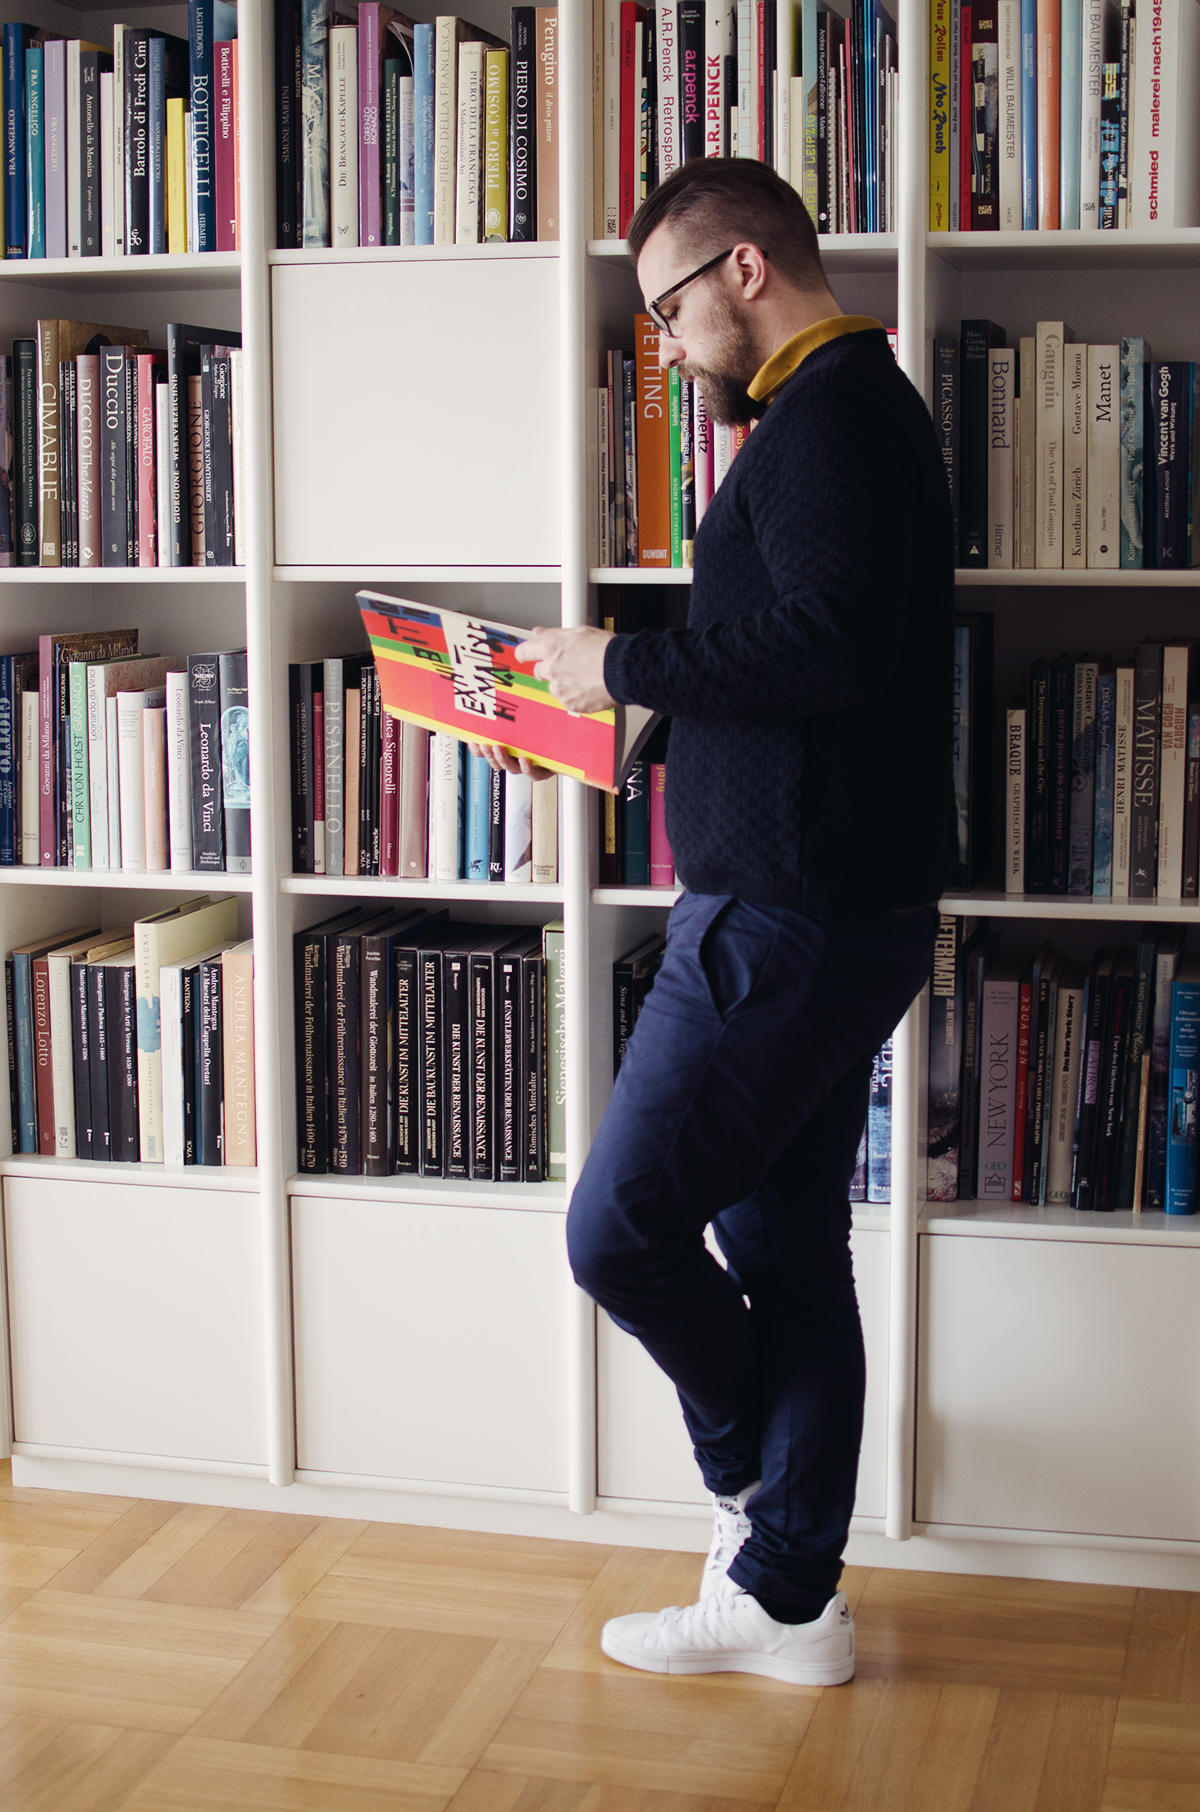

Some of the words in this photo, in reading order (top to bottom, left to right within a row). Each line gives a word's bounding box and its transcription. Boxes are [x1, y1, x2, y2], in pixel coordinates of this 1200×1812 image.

[196, 7, 204, 58] LIGHTBOWN
[661, 8, 674, 82] A.R.Penck
[818, 29, 827, 50] Andrea
[134, 41, 148, 68] Cini
[220, 47, 231, 87] Botticelli
[540, 18, 558, 85] Perugino
[1152, 36, 1163, 75] nach
[30, 70, 39, 86] FRA
[133, 74, 146, 105] Fredi
[468, 71, 478, 101] PIERO
[487, 65, 501, 124] COSIMO
[515, 61, 528, 107] PIERO
[682, 50, 700, 123] a.r.penck
[932, 73, 948, 107] Neo
[1005, 66, 1015, 91] WILLI
[30, 90, 39, 135] ANGELICO
[85, 95, 95, 132] Antonello
[134, 112, 146, 123] di
[219, 98, 232, 138] Filippino
[468, 106, 478, 140] DELLA
[515, 113, 528, 130] DI
[545, 100, 554, 116] divin
[1151, 79, 1161, 137] malerei
[86, 135, 95, 144] da
[192, 74, 210, 197] BOTTICELLI
[363, 107, 371, 145] LORENZO
[370, 107, 378, 145] MONACO
[545, 119, 554, 142] pittore
[662, 97, 677, 179] Retrospekt
[818, 116, 827, 138] Malerei
[932, 110, 948, 153] Rauch
[1005, 95, 1015, 159] BAUMEISTER
[85, 147, 95, 177] Messina
[133, 129, 146, 176] Bartolo
[487, 141, 500, 188] PIERO
[515, 136, 528, 200] COSIMO
[467, 144, 477, 204] FRANCESCA
[1148, 150, 1160, 220] schmied
[198, 213, 207, 246] HIRMER
[43, 331, 52, 365] BELLOSI
[215, 363, 228, 398] Giorgione
[1041, 334, 1061, 409] Gauguin
[1072, 353, 1082, 389] Moreau
[1158, 366, 1170, 396] Gogh
[104, 354, 124, 429] Duccio
[991, 361, 1010, 449] Bonnard
[1095, 364, 1112, 422] Manet
[79, 378, 92, 448] DUCCIO
[1072, 394, 1082, 435] Gustave
[1159, 400, 1169, 419] van
[1169, 403, 1177, 429] Wirkung
[38, 383, 58, 500] CIMABUE
[141, 408, 153, 466] GAROFALO
[203, 410, 212, 448] GIORGIONE
[1157, 422, 1169, 464] Vincent
[80, 451, 93, 477] The
[1048, 440, 1057, 457] The
[188, 401, 205, 534] GIORGIONE
[1048, 459, 1057, 473] Art
[1048, 475, 1057, 486] of
[1071, 467, 1082, 499] Zürich
[80, 478, 94, 521] Maestà
[1047, 488, 1057, 506] Paul
[994, 524, 1004, 557] Hirmer
[1046, 508, 1057, 546] Gauguin
[1071, 503, 1082, 556] Kunsthaus
[641, 549, 668, 558] DUMONT
[175, 688, 185, 726] Leonardo
[1101, 687, 1111, 721] DEGAS
[1163, 703, 1175, 728] GOGH
[175, 727, 185, 738] da
[384, 712, 396, 738] Luca
[1099, 725, 1109, 746] beyond
[1162, 731, 1174, 749] VAN
[1173, 707, 1186, 748] GAUGUIN
[73, 735, 84, 768] HOLST
[176, 740, 185, 759] Vinci
[199, 723, 213, 779] Leonardo
[1008, 725, 1022, 775] BRAQUE
[1117, 725, 1127, 773] MATISSE
[1134, 698, 1156, 807] MATISSE
[325, 701, 341, 833] PISANELLO
[383, 742, 396, 794] Signorelli
[75, 772, 84, 797] VON
[201, 783, 212, 797] da
[1115, 778, 1125, 814] HENRI
[75, 800, 85, 823] CHR
[202, 801, 215, 832] Vinci
[1012, 783, 1021, 845] GRAPHISCHES
[1012, 849, 1021, 874] WERK
[303, 945, 314, 998] Wandmalerei
[312, 945, 321, 968] Roettgen
[335, 945, 346, 1000] Wandmalerei
[344, 945, 352, 968] Roettgen
[933, 916, 957, 996] AFTERMATH
[203, 978, 211, 1004] Maestri
[210, 968, 219, 994] Andrea
[369, 970, 379, 1019] Wandmalerei
[619, 986, 628, 1007] Siena
[35, 971, 49, 1026] Lorenzo
[202, 1006, 211, 1023] della
[210, 996, 219, 1030] Mantegna
[235, 975, 247, 1043] ANDREA
[304, 1001, 314, 1014] der
[336, 1002, 346, 1015] der
[619, 1009, 628, 1022] and
[946, 998, 955, 1010] JOEL
[201, 1026, 211, 1057] Cappella
[369, 1022, 379, 1034] der
[452, 1024, 462, 1039] DIE
[619, 1026, 629, 1037] the
[965, 1002, 976, 1052] SEPTEMBER
[1111, 1036, 1121, 1051] Über
[37, 1031, 50, 1066] Lotto
[304, 1017, 315, 1084] Frührenaissance
[336, 1018, 347, 1085] Frührenaissance
[369, 1036, 379, 1071] Giottozeit
[451, 1041, 462, 1072] KUNST
[503, 1000, 514, 1091] KÜNSTLERWERKSTÄTTEN
[965, 1056, 975, 1067] 11
[1111, 1052, 1120, 1064] den
[1131, 1033, 1143, 1062] Chicago
[203, 1058, 212, 1084] Ovetari
[452, 1074, 462, 1091] DER
[989, 1034, 1010, 1098] YORK
[1109, 1066, 1119, 1092] Dächern
[235, 1051, 248, 1145] MANTEGNA
[305, 1096, 315, 1121] Italien
[337, 1098, 347, 1123] Italien
[369, 1084, 378, 1103] Italien
[504, 1093, 513, 1107] DER
[452, 1093, 462, 1158] RENAISSANCE
[986, 1097, 1008, 1148] NEW
[1105, 1123, 1114, 1137] York
[1106, 1108, 1115, 1122] New
[504, 1109, 513, 1160] RENAISSANCE
